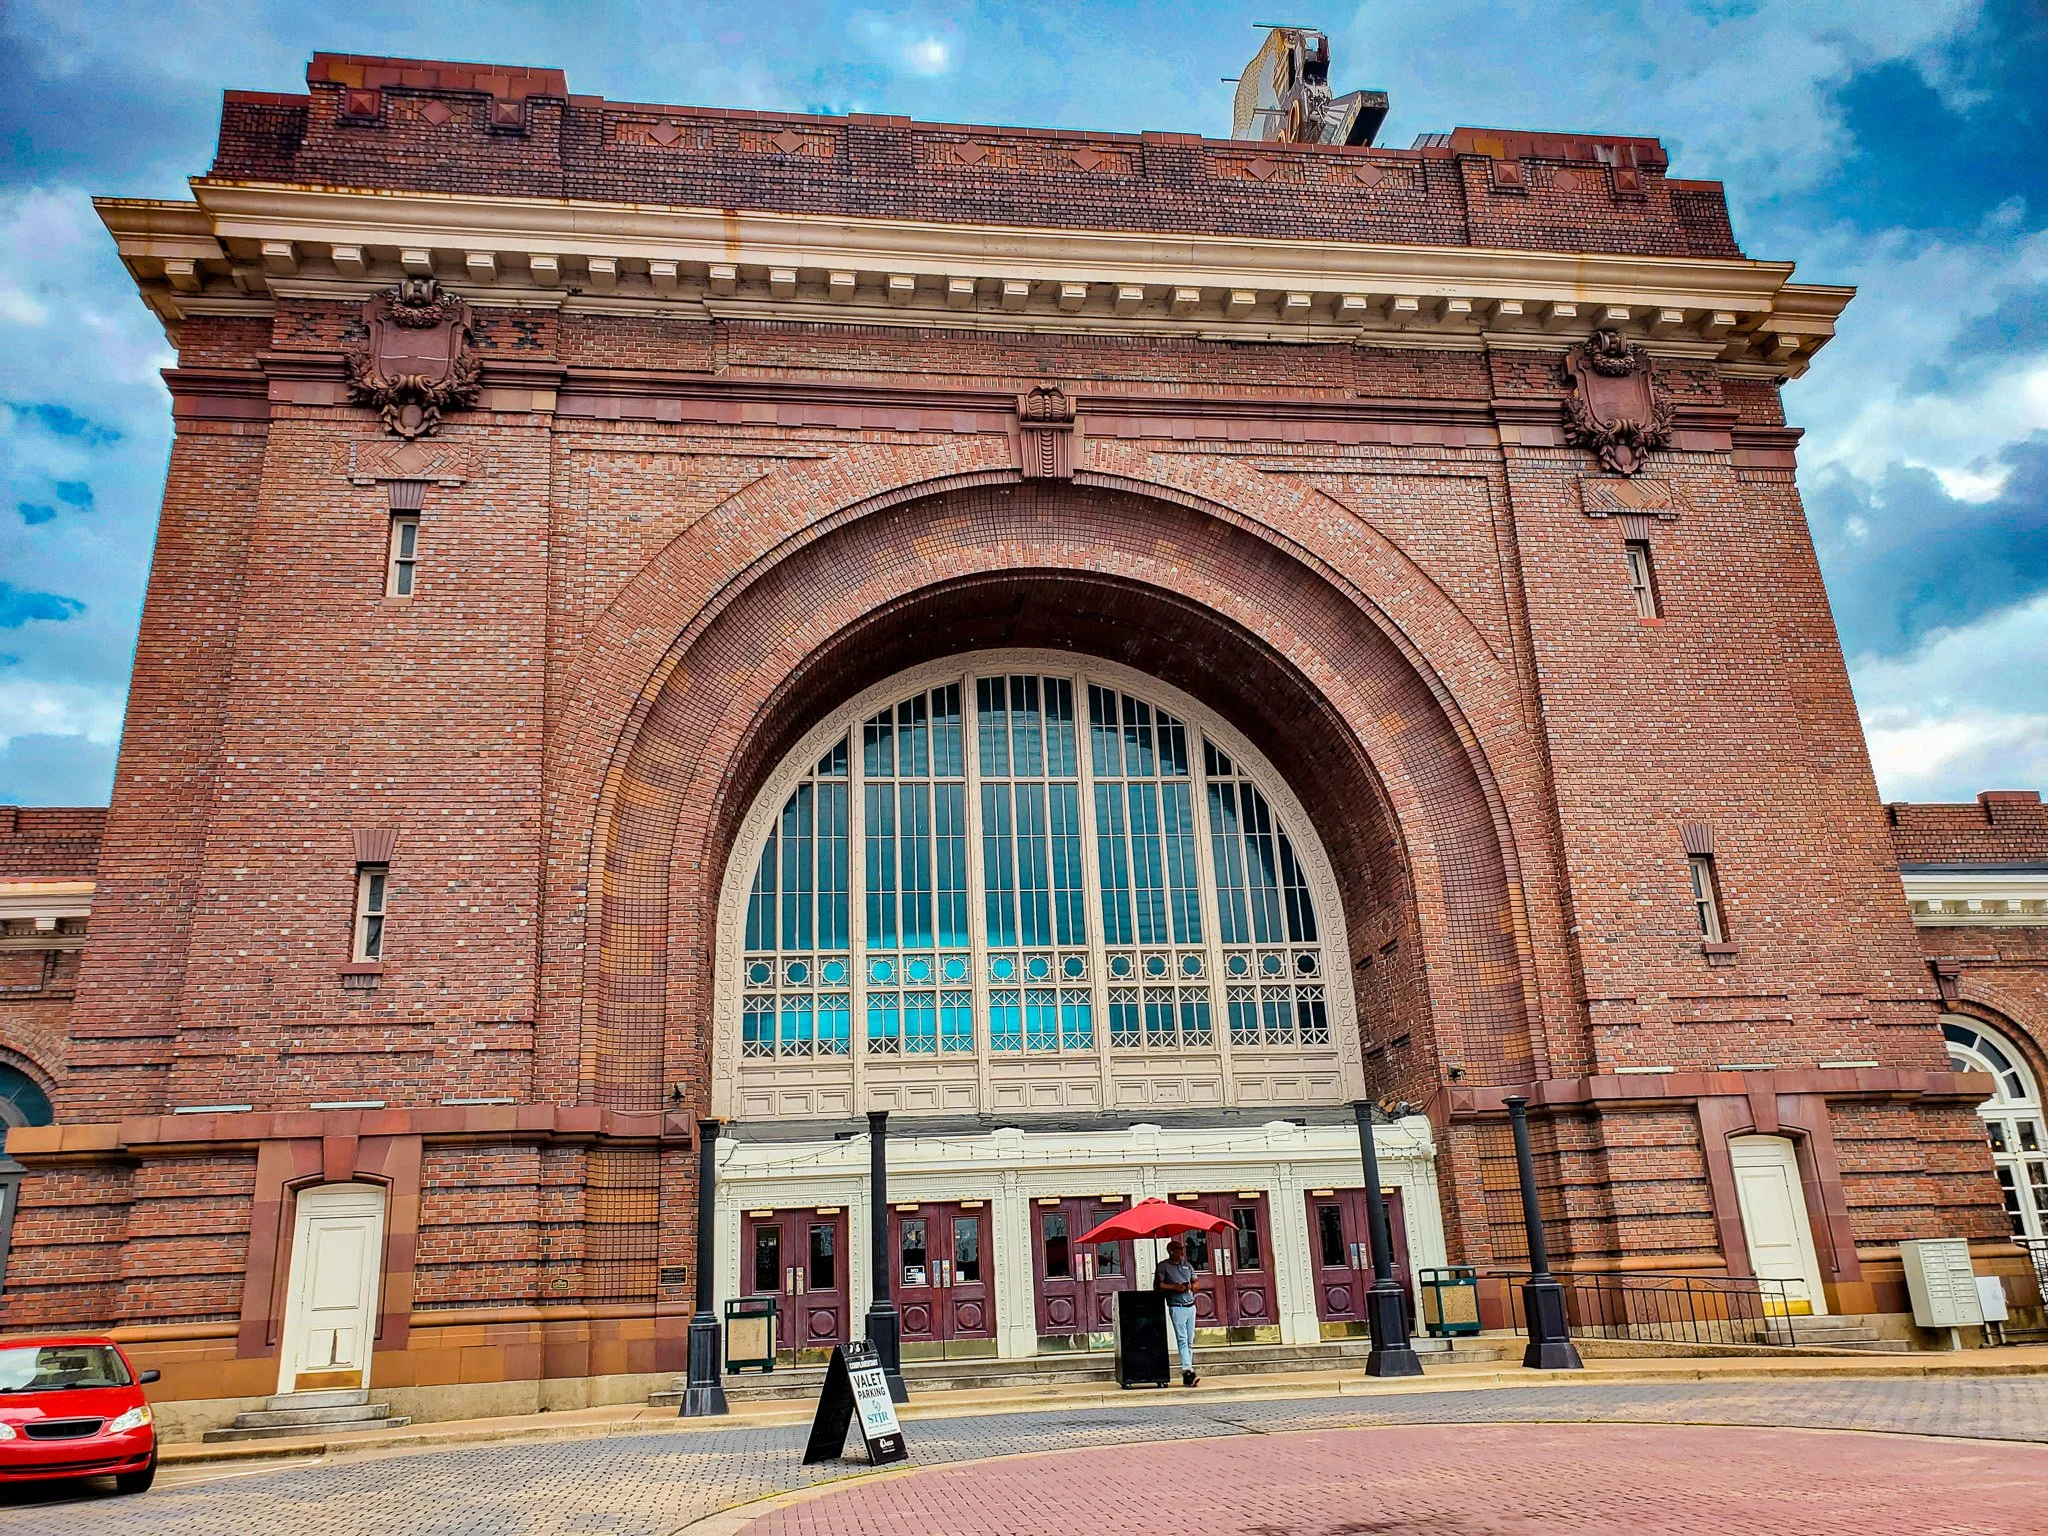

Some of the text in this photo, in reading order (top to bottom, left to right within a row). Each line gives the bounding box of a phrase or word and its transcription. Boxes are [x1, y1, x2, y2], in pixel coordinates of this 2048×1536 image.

[853, 1372, 881, 1388] VALET
[858, 1387, 886, 1400] PARKING
[867, 1411, 889, 1423] STIR
